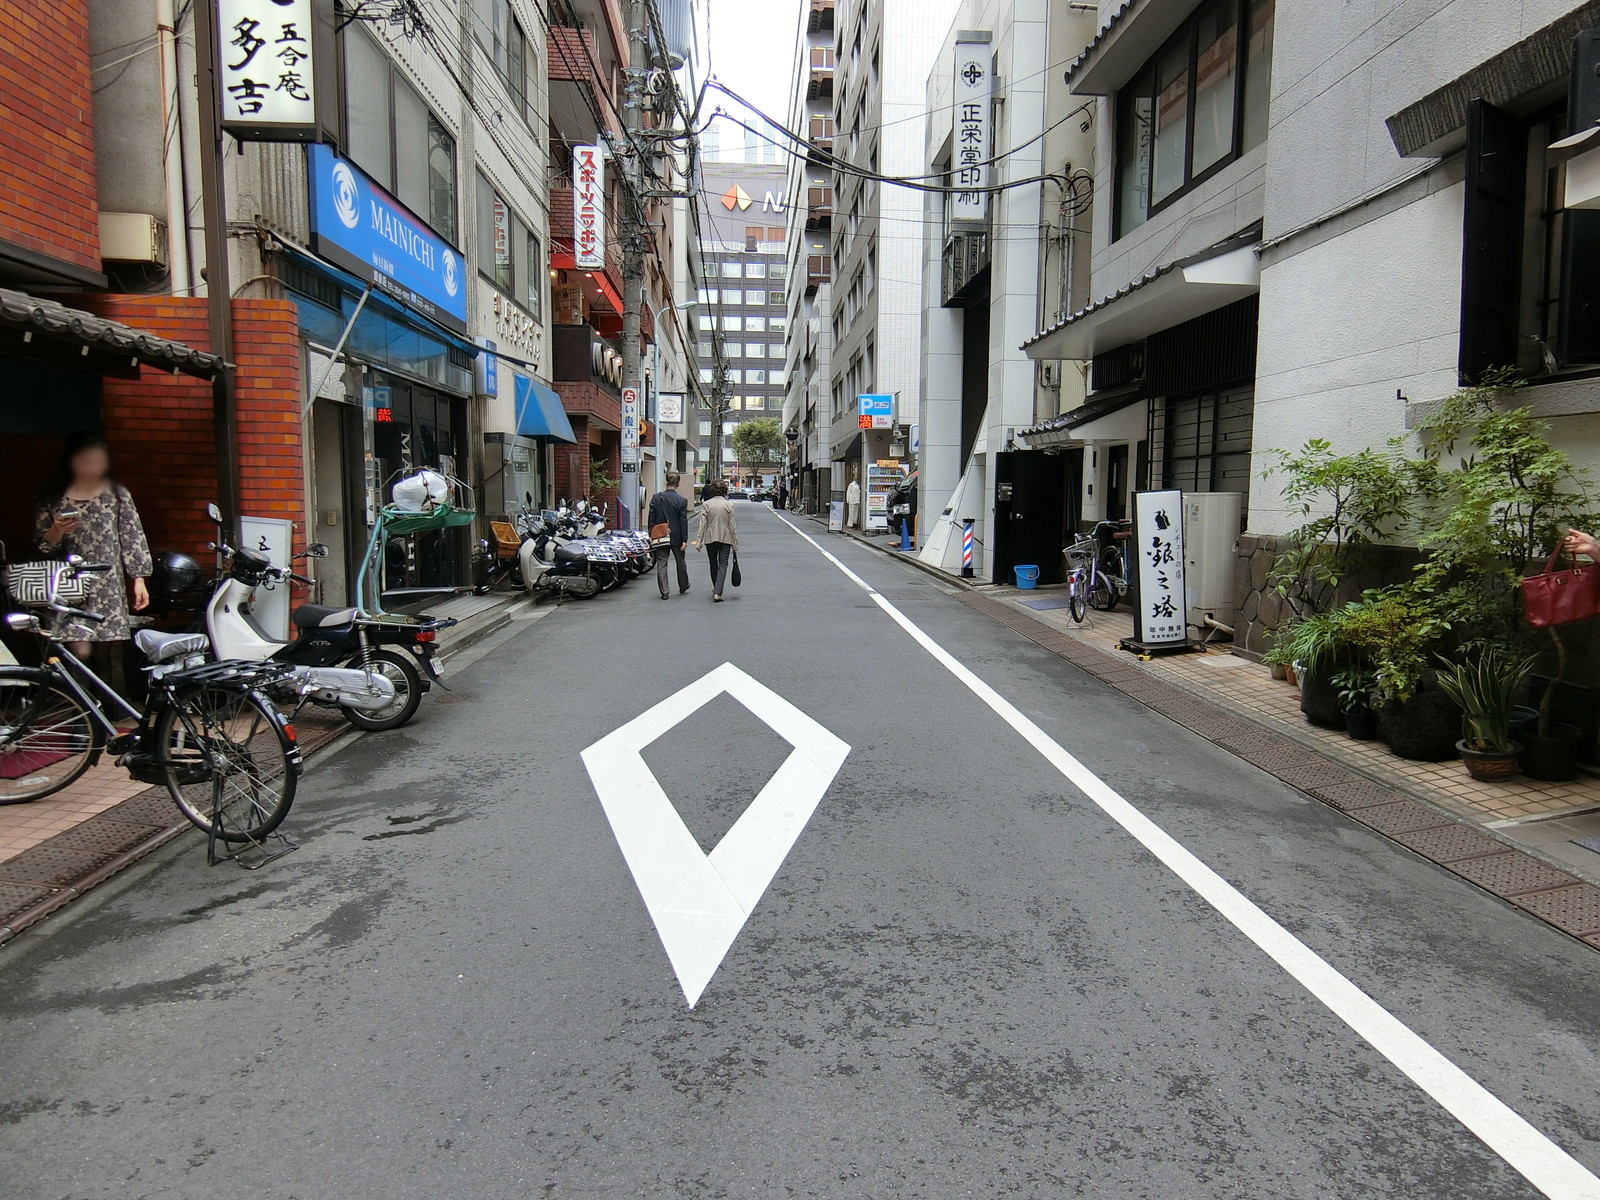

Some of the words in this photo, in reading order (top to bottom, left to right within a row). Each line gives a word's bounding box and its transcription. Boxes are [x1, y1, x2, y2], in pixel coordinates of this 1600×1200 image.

[275, 22, 311, 102] 五合庵
[957, 103, 983, 206] 正栄堂印刷
[370, 199, 435, 272] MAINICHI
[578, 150, 598, 257] スポーツニッポン
[372, 251, 395, 276] 毎日新聞
[859, 415, 872, 429] 満
[860, 398, 873, 416] P
[1146, 536, 1178, 618] 銀之塔
[1173, 525, 1182, 580] シチューの店
[1149, 624, 1182, 634] 年中無休
